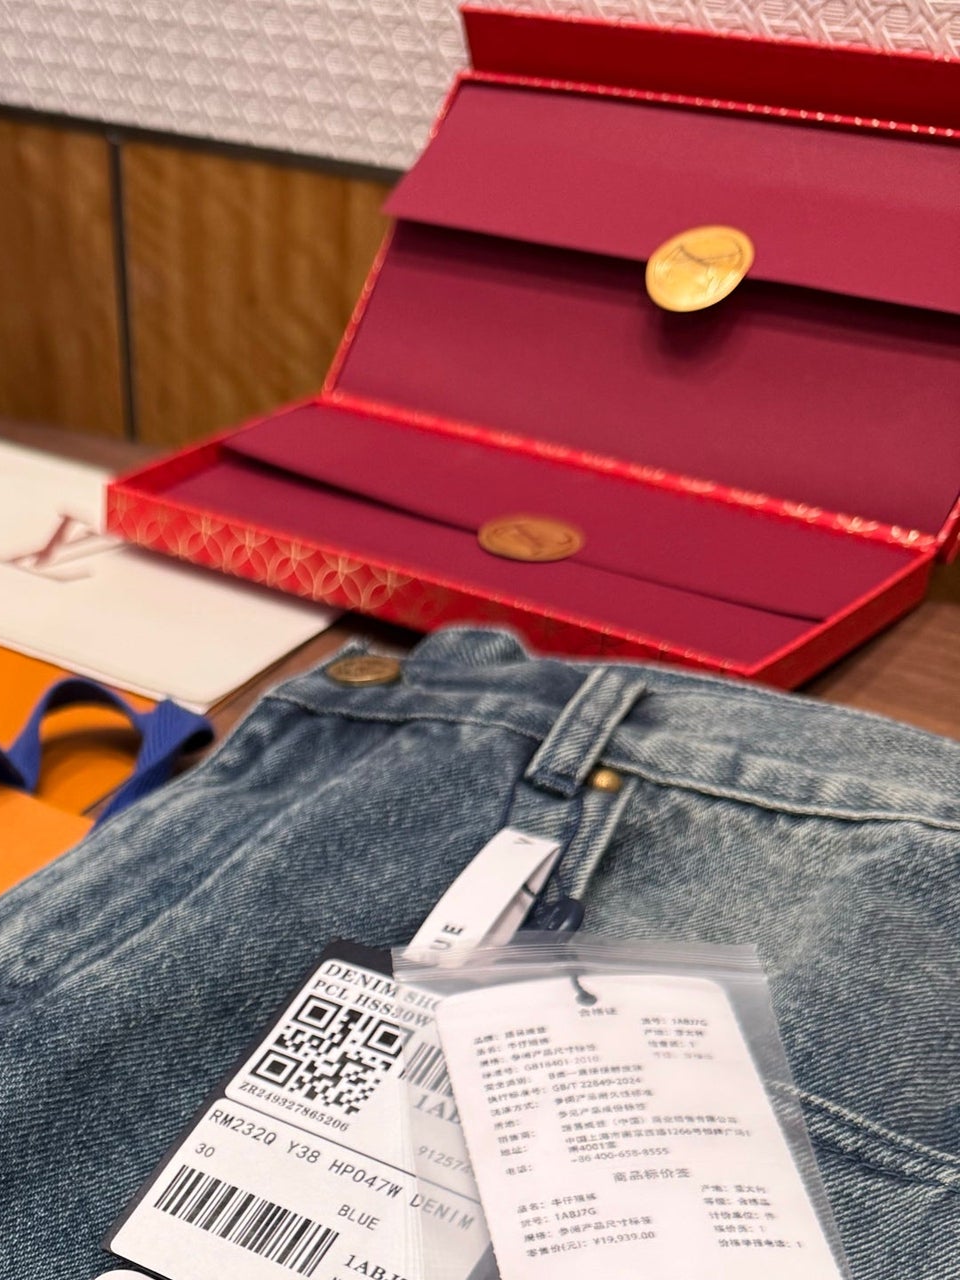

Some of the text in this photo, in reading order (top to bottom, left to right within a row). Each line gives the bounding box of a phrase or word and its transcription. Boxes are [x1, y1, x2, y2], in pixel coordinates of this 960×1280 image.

[324, 963, 400, 999] DENIM
[313, 980, 435, 1028] PCL HSS30W
[238, 1081, 350, 1132] ZR249327865206
[195, 1143, 215, 1158] 30
[209, 1109, 277, 1146] RM232Q
[286, 1140, 321, 1164] Y38
[410, 1194, 475, 1230] DENIM
[337, 1204, 380, 1231] BLUE
